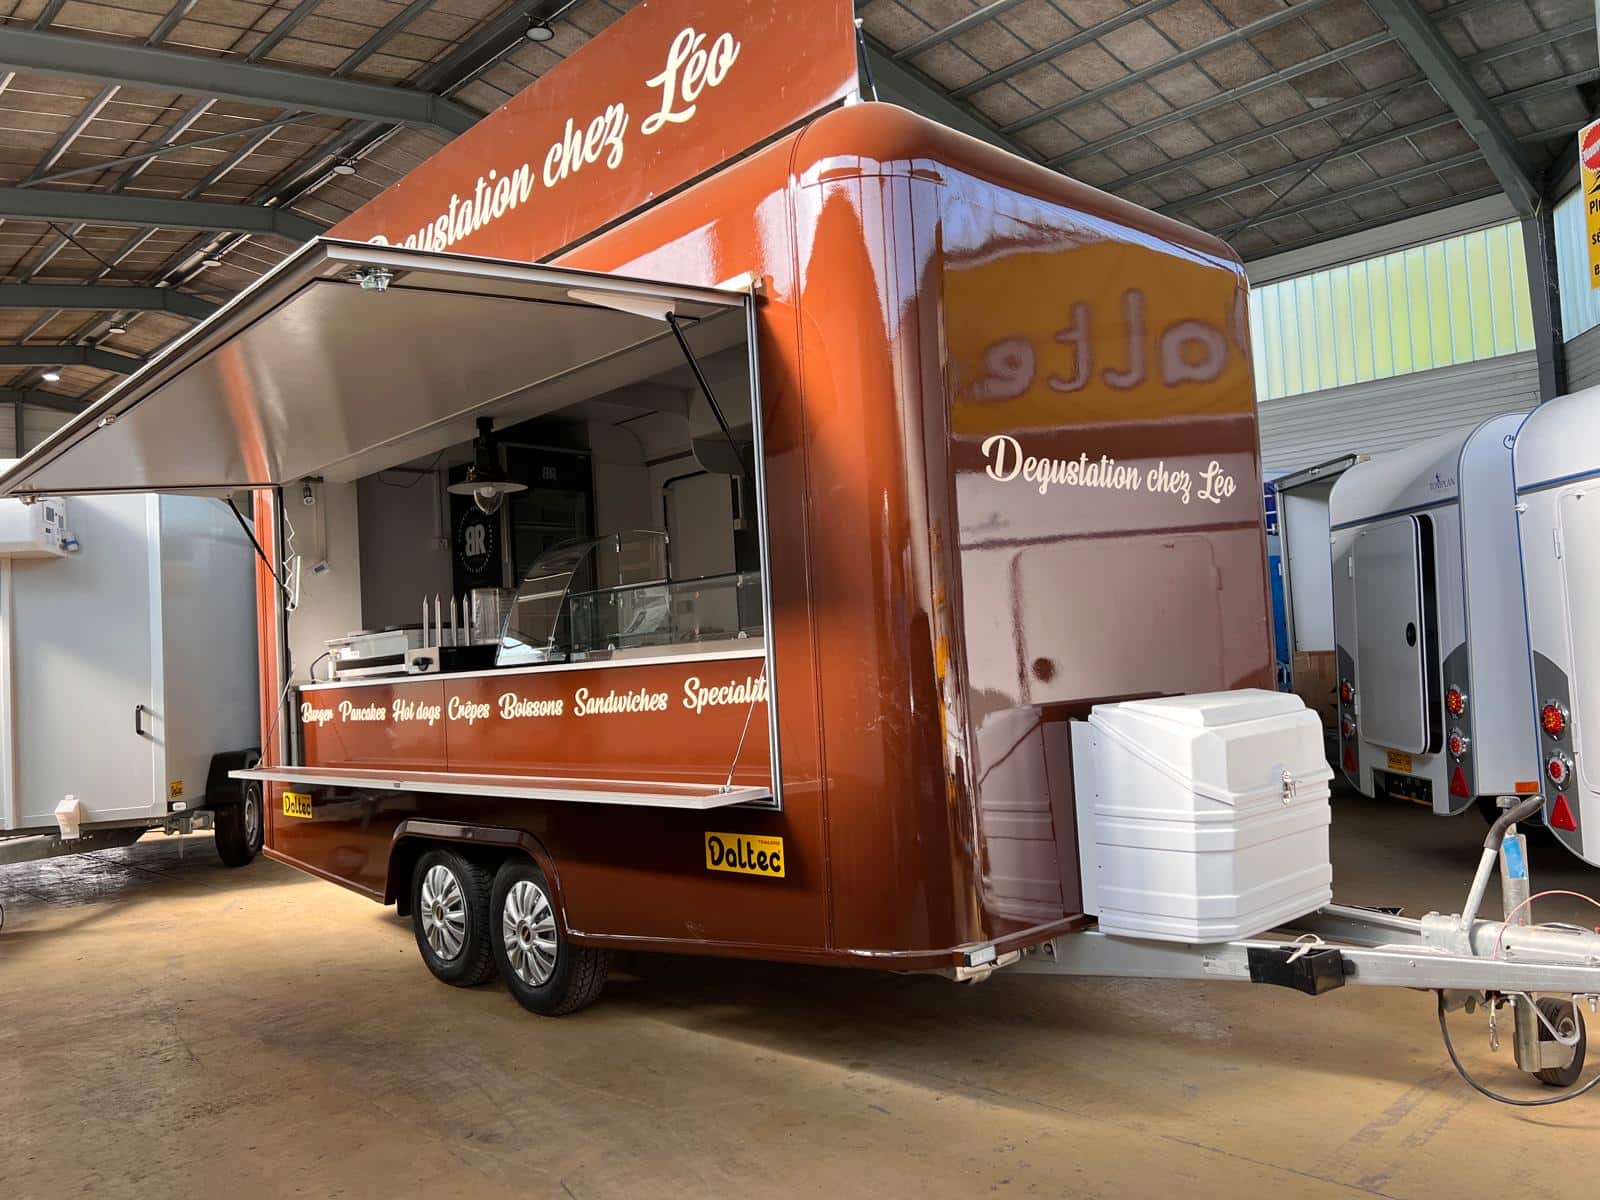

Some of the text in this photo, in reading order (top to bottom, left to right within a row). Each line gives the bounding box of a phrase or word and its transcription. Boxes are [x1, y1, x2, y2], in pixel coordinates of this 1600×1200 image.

[542, 102, 630, 187] chez
[641, 26, 742, 135] Léo
[981, 434, 1237, 504] Degustation chez Léo
[300, 702, 334, 727] Burger
[338, 700, 387, 722] Pancakes
[392, 698, 415, 722] Hot
[415, 700, 441, 726] dogs
[448, 695, 491, 726] Crêpes
[498, 692, 564, 720] Boissons
[574, 687, 669, 717] Sandwiches
[708, 836, 781, 873] Daltec
